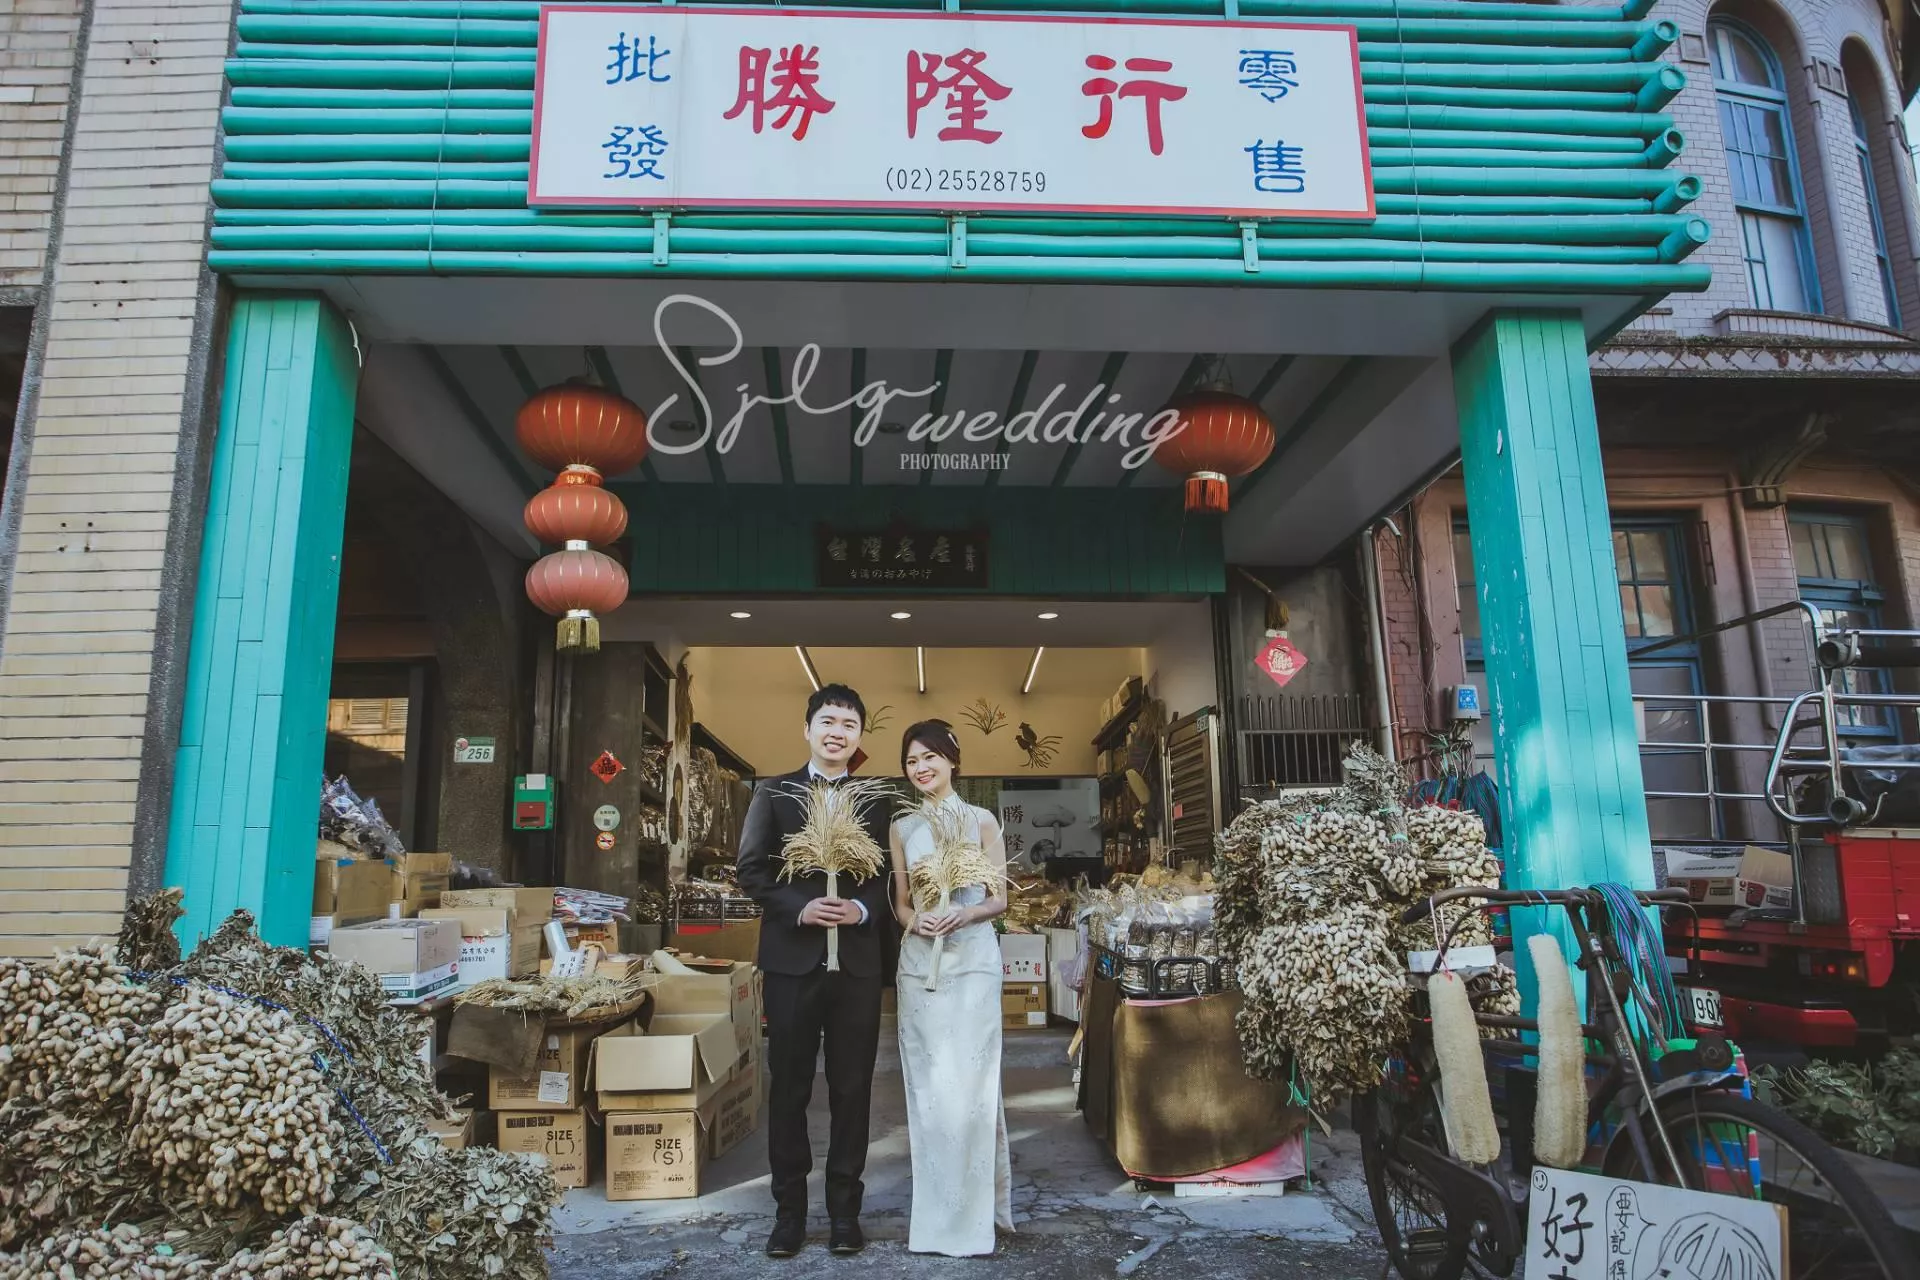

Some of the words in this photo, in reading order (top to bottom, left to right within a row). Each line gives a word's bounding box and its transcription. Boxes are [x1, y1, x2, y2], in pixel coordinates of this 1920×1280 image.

[602, 31, 672, 181] 批發
[722, 44, 1188, 156] 勝隆行
[1238, 49, 1306, 194] 零售
[885, 168, 1047, 195] (02)25528759
[467, 748, 490, 760] 256
[547, 1130, 573, 1141] SIZE
[655, 1138, 681, 1150] SIZE
